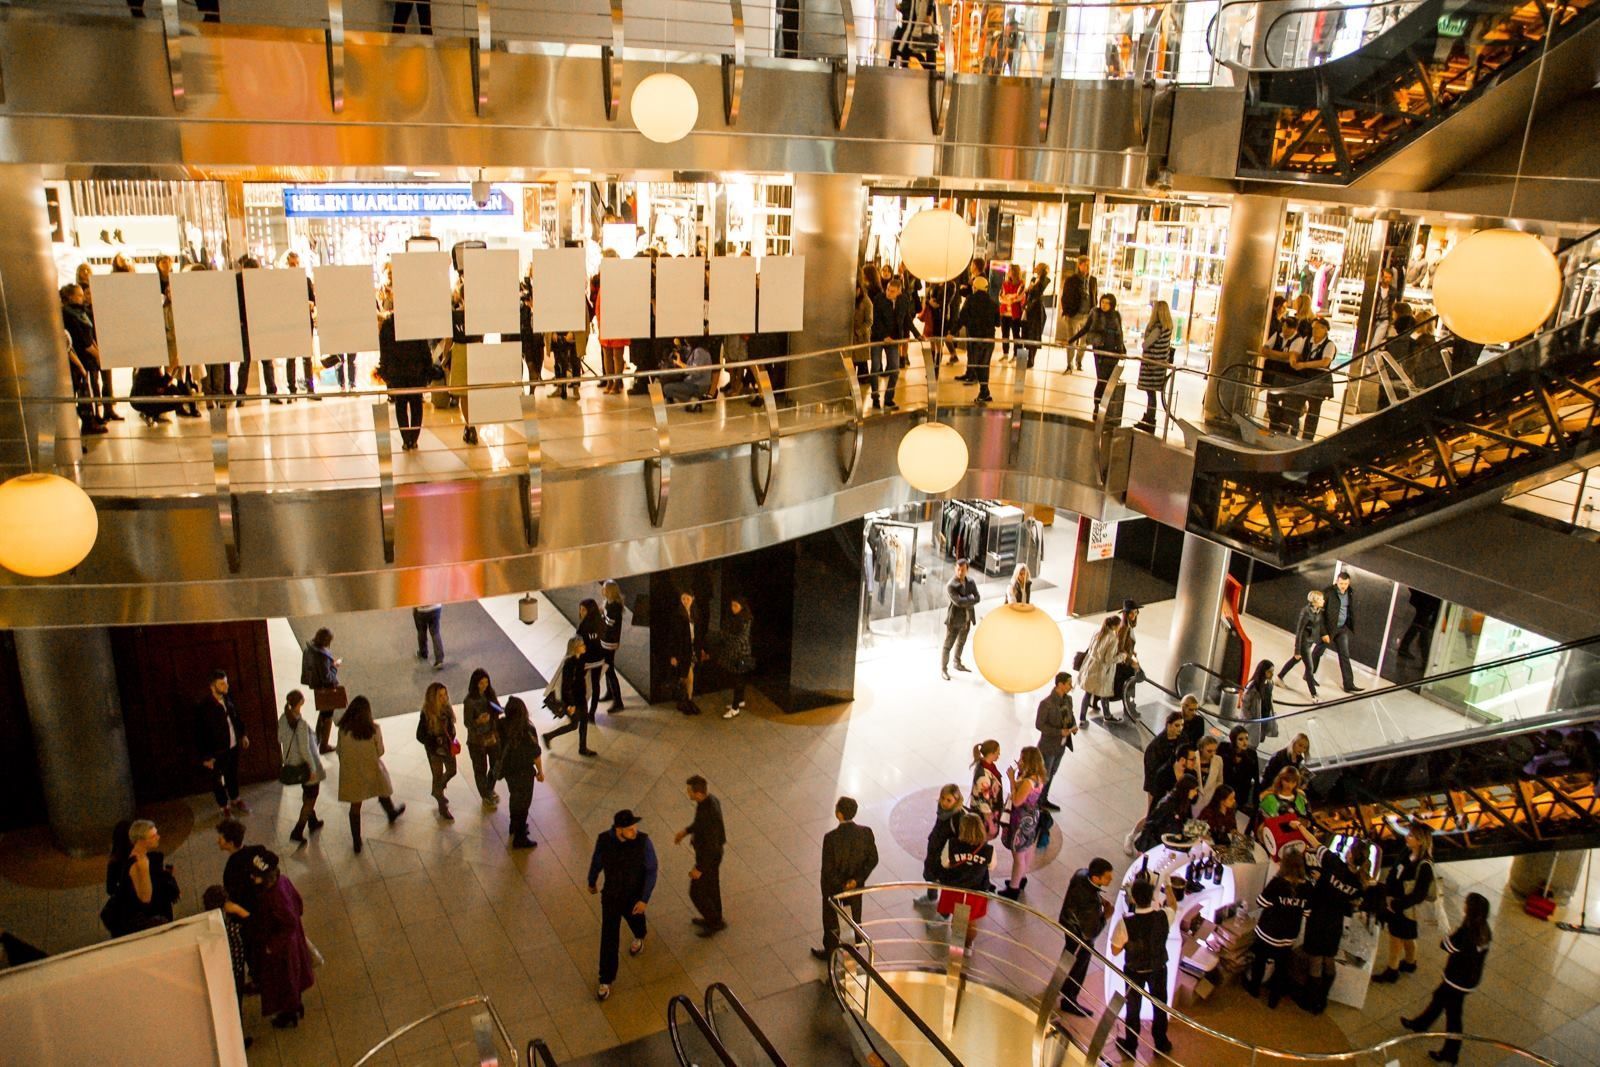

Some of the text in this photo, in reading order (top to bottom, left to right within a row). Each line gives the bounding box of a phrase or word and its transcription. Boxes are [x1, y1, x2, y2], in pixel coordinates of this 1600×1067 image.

[292, 194, 502, 211] HELEN MARLEN MANDAIN
